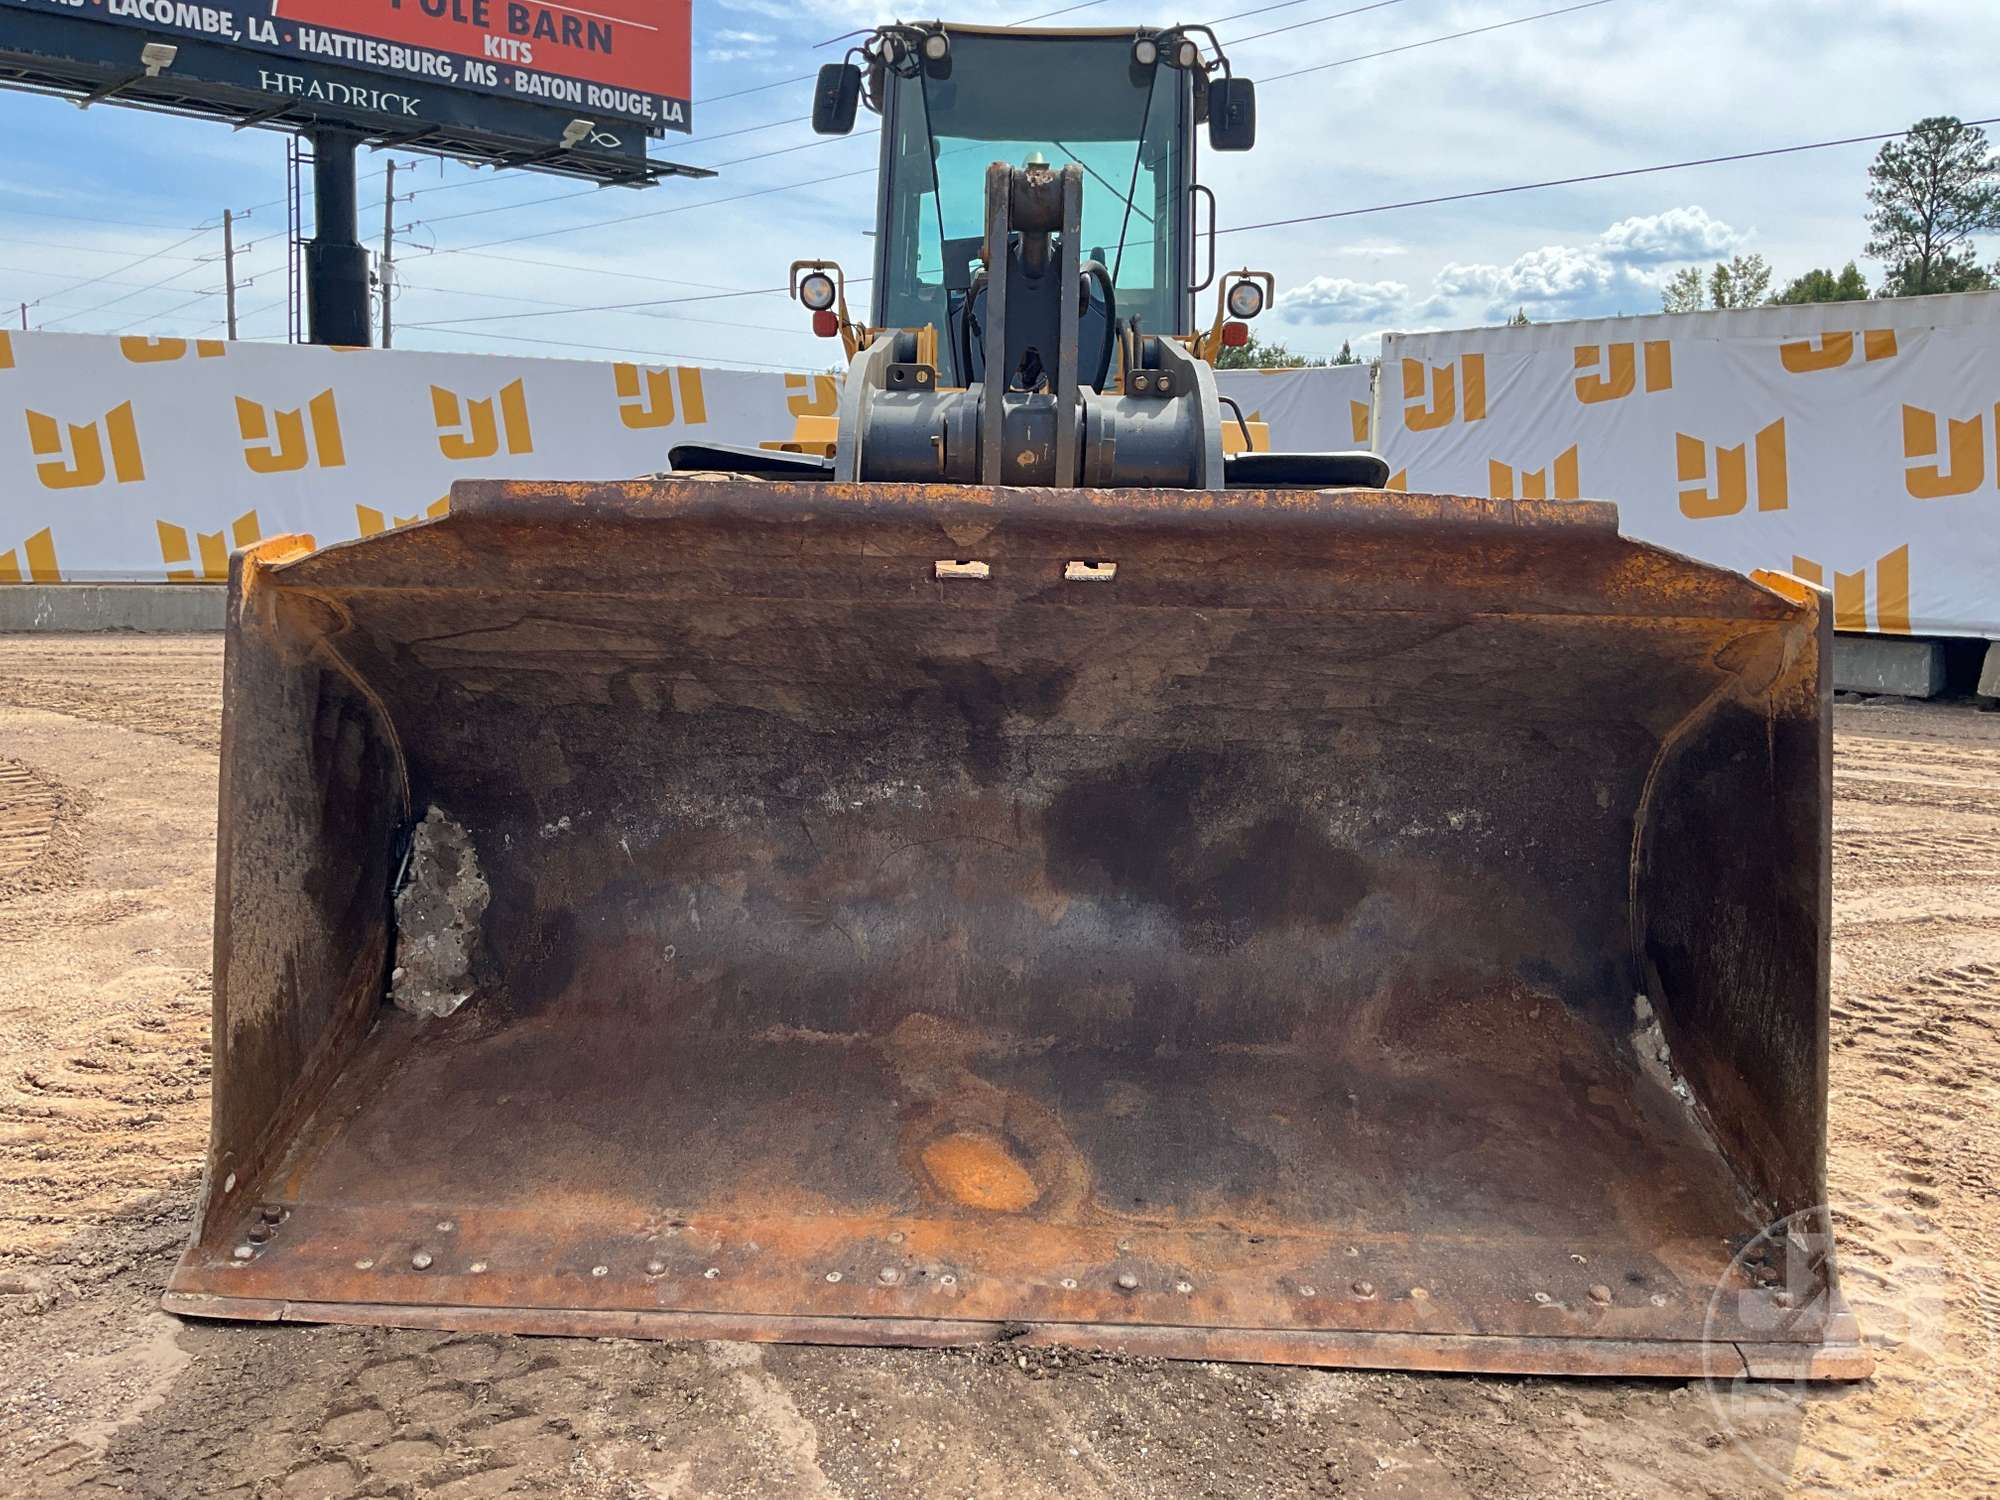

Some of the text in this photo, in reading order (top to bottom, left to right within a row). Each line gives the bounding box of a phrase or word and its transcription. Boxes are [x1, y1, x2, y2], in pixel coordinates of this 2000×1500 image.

[391, 0, 613, 54] OLE BARN
[483, 34, 533, 64] KITS
[108, 0, 684, 123] LACOMBE, LA HATTIESBURG, MS BATON ROUGE, LA
[258, 70, 421, 116] HEADRICK
